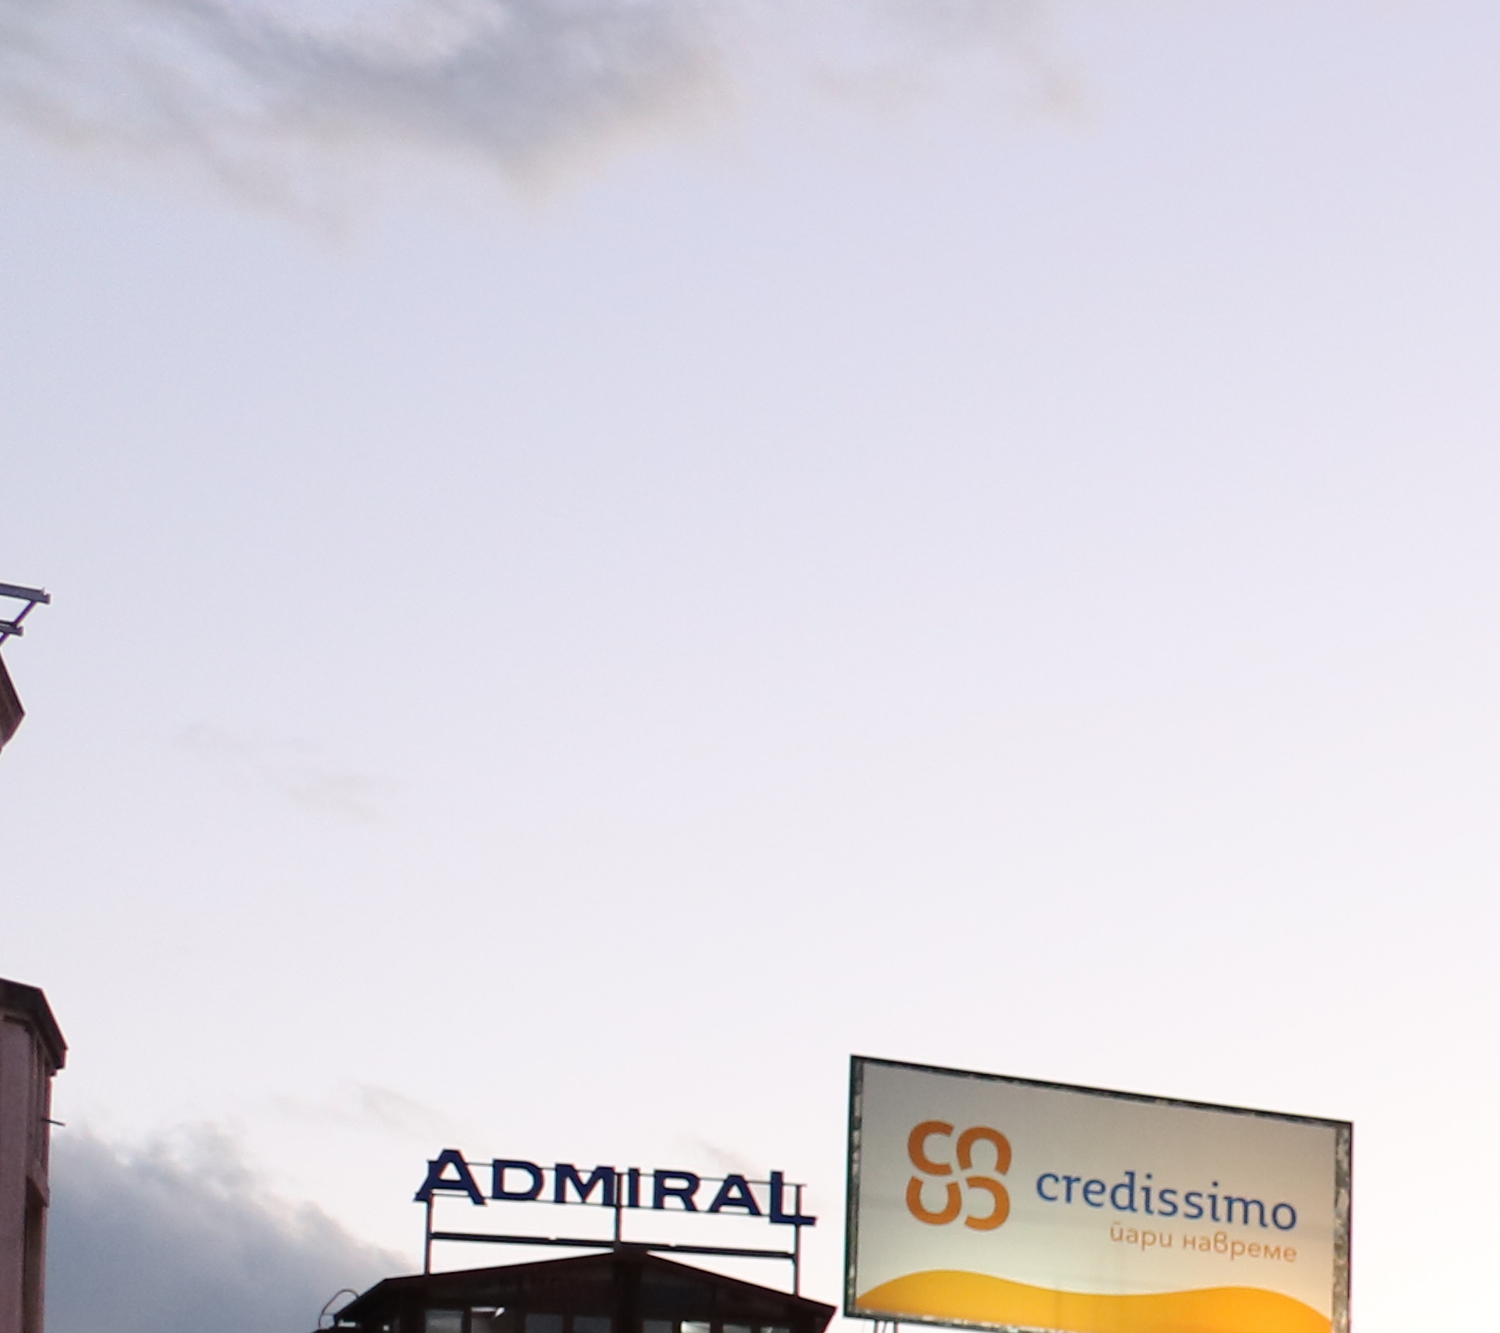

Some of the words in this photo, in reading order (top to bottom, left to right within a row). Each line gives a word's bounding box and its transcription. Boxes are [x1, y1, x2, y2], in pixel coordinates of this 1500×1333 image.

[414, 1148, 817, 1226] ADMIRAL
[1036, 1170, 1298, 1231] credissimo
[1183, 1224, 1298, 1263] навреме
